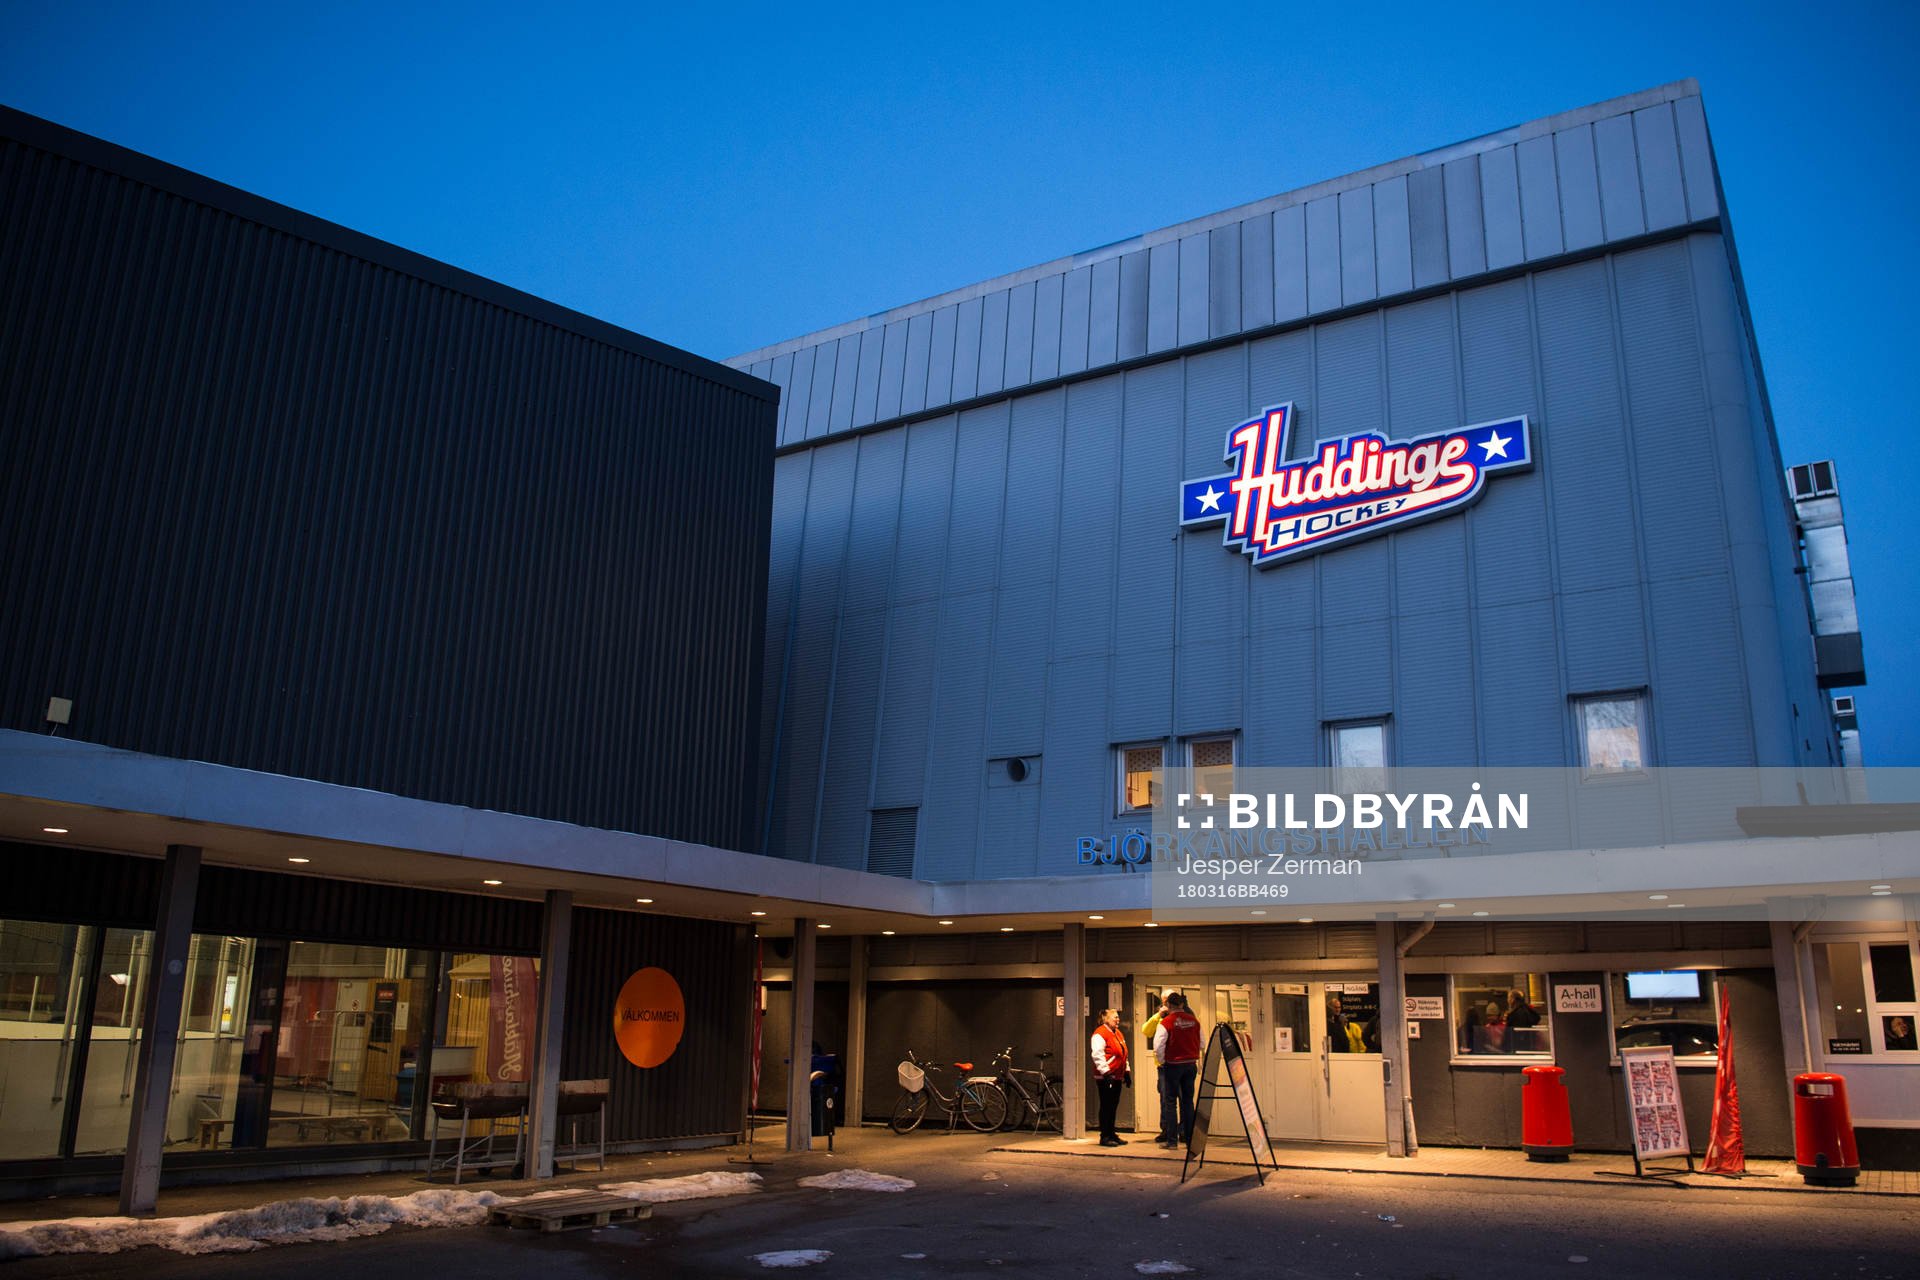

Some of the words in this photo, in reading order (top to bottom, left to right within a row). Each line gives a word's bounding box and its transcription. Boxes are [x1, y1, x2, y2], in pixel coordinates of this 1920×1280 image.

[1230, 410, 1476, 540] Huddinge
[1271, 497, 1407, 546] HOCKEY
[1561, 987, 1596, 999] A-hall
[622, 1007, 680, 1022] VÄLKOMMEN
